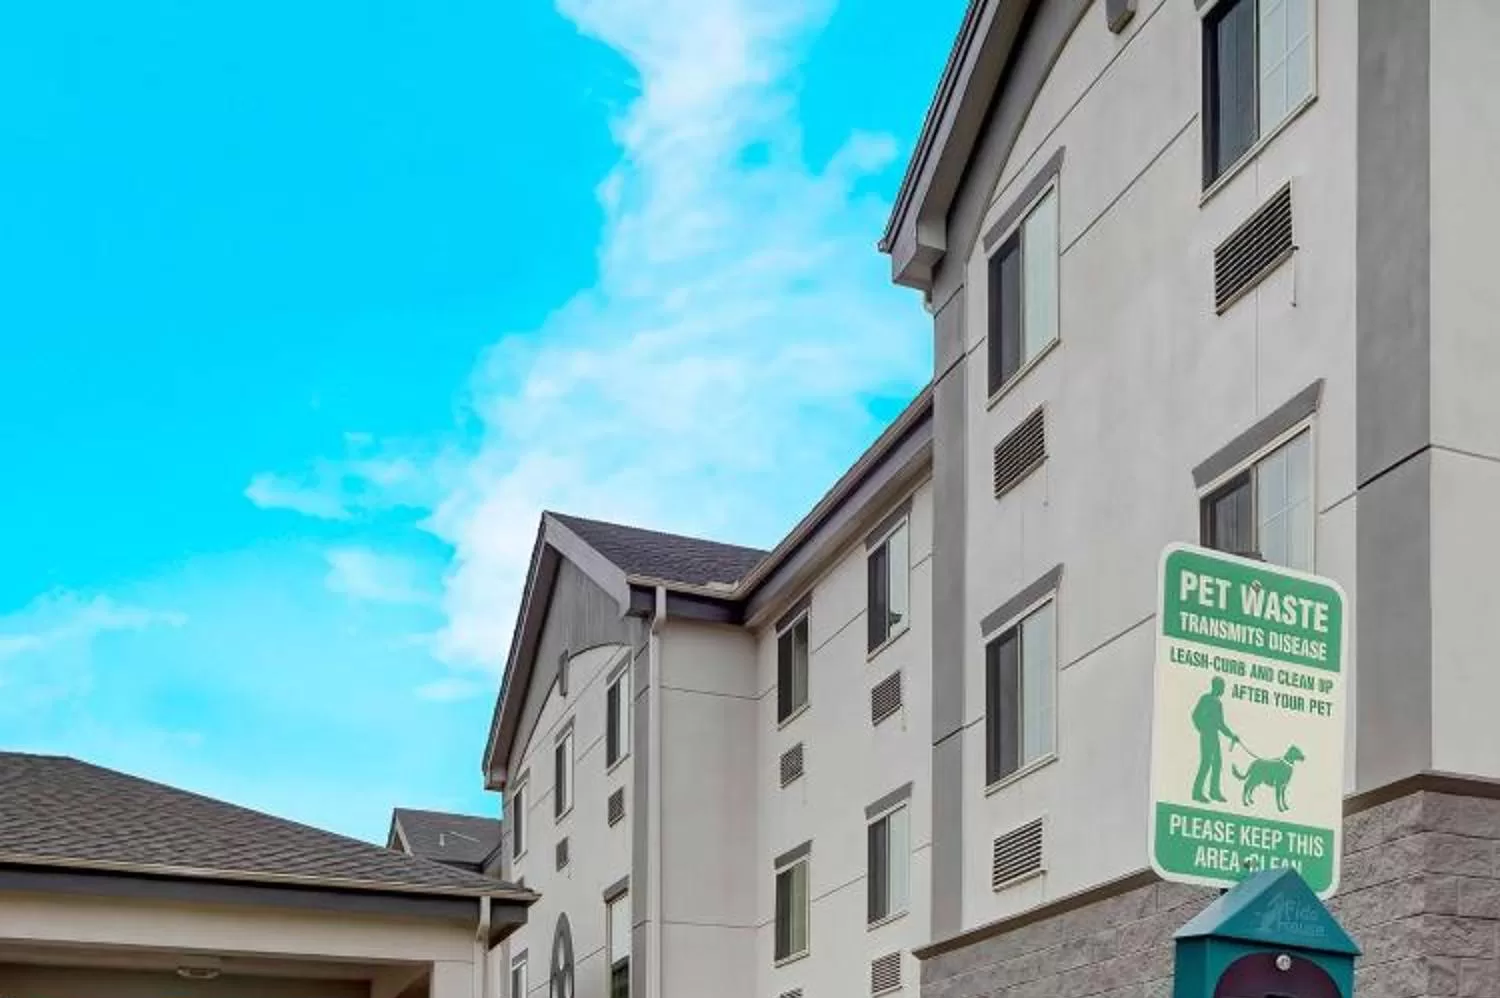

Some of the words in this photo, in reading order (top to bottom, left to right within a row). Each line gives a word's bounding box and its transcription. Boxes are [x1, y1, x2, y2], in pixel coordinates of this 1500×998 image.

[1179, 569, 1232, 610] PET
[1240, 582, 1329, 633] WASTE
[1180, 611, 1265, 648] TRANSMITS
[1269, 630, 1327, 662] DISEASE
[1170, 645, 1245, 677] LEASH-CURB
[1249, 663, 1274, 682] AND
[1277, 668, 1315, 691] CLEAN
[1319, 679, 1334, 695] UP
[1232, 683, 1269, 706] AFTER
[1273, 690, 1305, 713] YOUR
[1309, 699, 1333, 718] PET
[1169, 813, 1235, 845] PLEASE
[1240, 822, 1283, 851] KEEP
[1287, 832, 1325, 858] THIS
[1194, 845, 1240, 873] AREA
